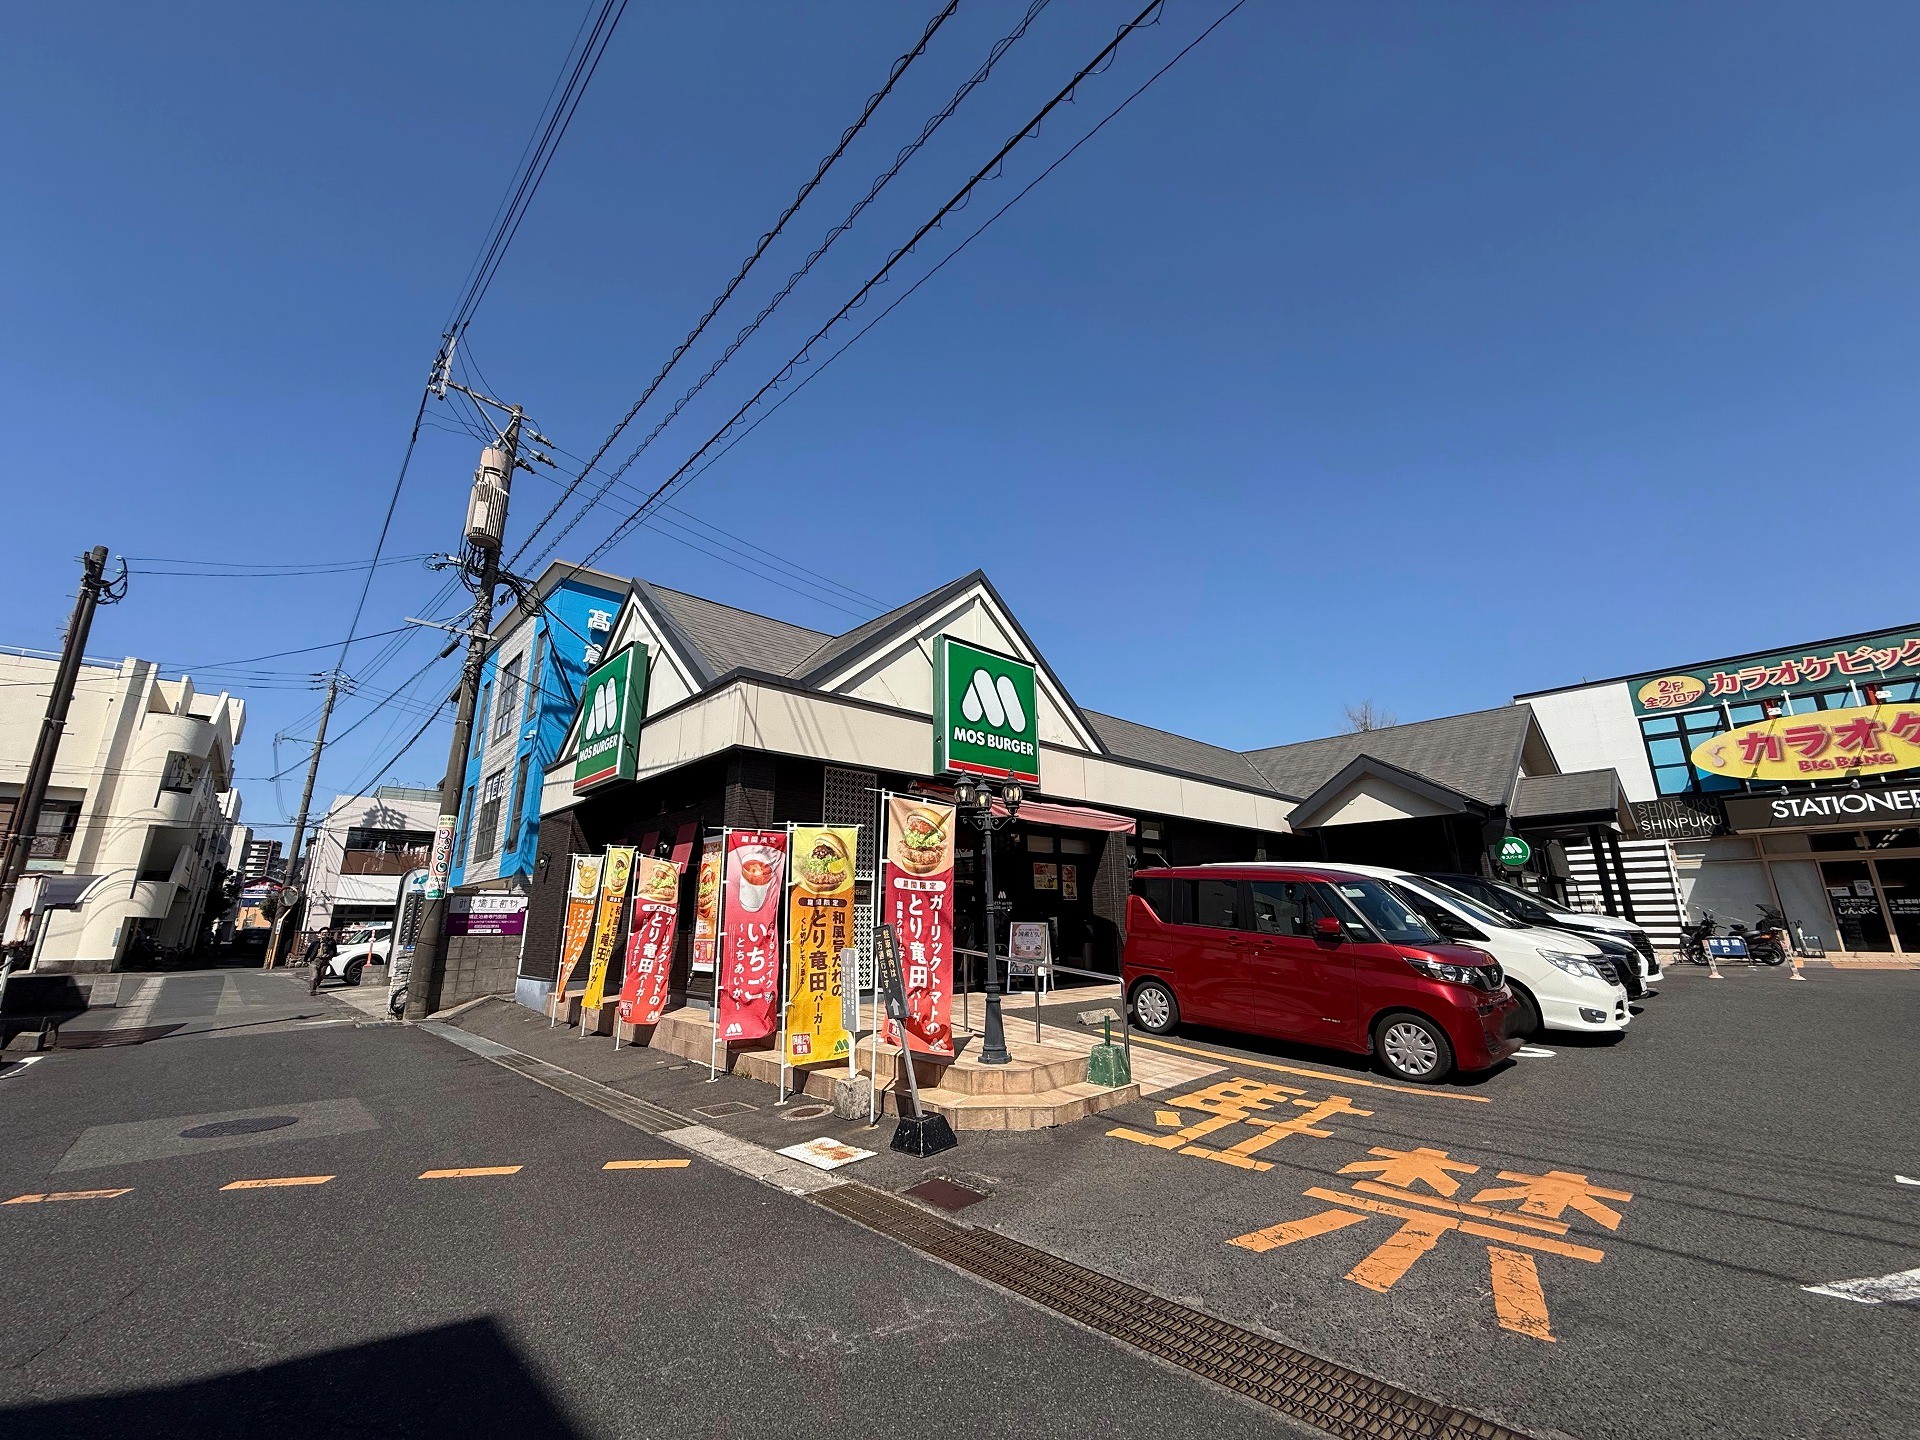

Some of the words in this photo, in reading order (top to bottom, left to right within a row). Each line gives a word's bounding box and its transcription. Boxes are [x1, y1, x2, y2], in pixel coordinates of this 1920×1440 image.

[1644, 689, 1703, 709] 全フロア
[1657, 680, 1684, 694] 2F
[578, 746, 593, 763] MOS
[592, 734, 618, 756] BURGER
[954, 726, 985, 746] MOS
[987, 734, 1034, 756] BURGER
[1797, 758, 1831, 772] BIG
[1834, 752, 1897, 769] BANG
[1641, 814, 1723, 831] SHINPUKU
[903, 880, 937, 890] 期間限定
[807, 898, 839, 906] 期間限定
[1838, 906, 1878, 915] しんぷく
[636, 912, 663, 1005] とり竜田バーガー
[746, 923, 767, 1000] いちご
[875, 933, 892, 994] 一方通行です。
[926, 894, 944, 1035] ガーリックトマトの
[809, 910, 829, 1035] とり竜田バーガー
